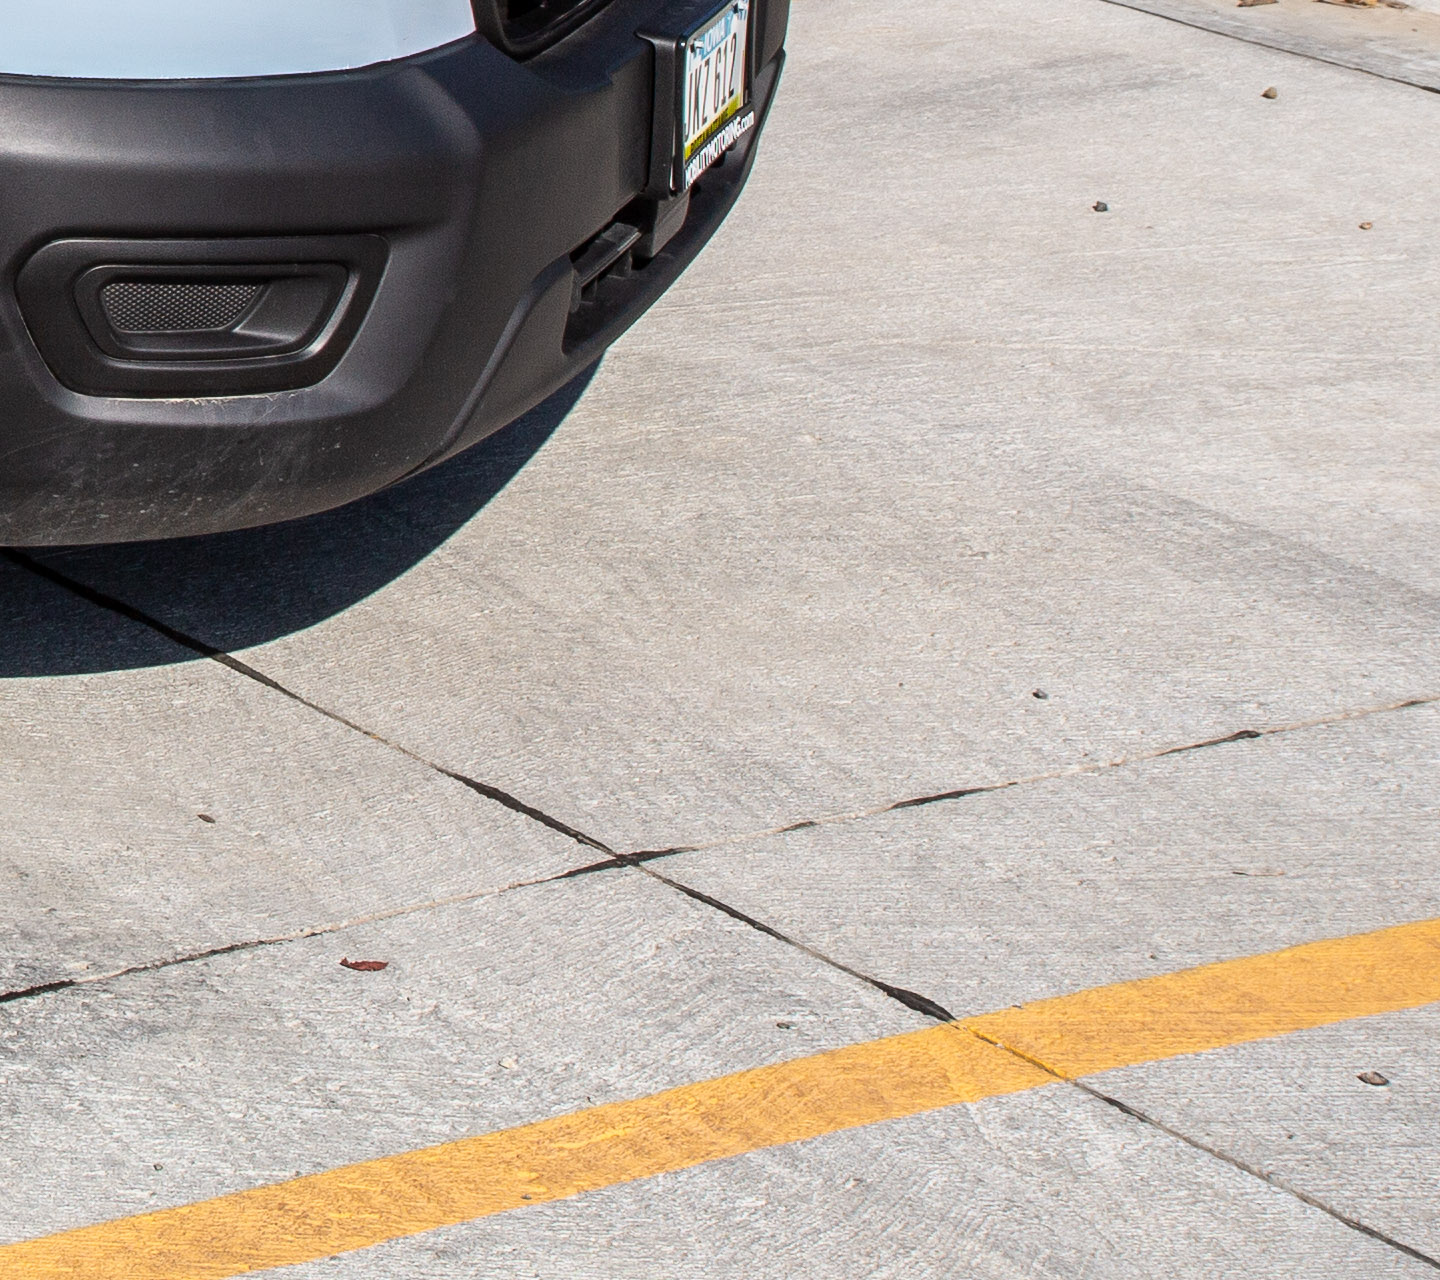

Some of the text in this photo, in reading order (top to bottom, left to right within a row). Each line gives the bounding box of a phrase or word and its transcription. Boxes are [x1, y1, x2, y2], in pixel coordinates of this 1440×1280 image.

[703, 16, 726, 56] IOWA
[684, 55, 712, 139] JKZ
[713, 31, 738, 115] 612
